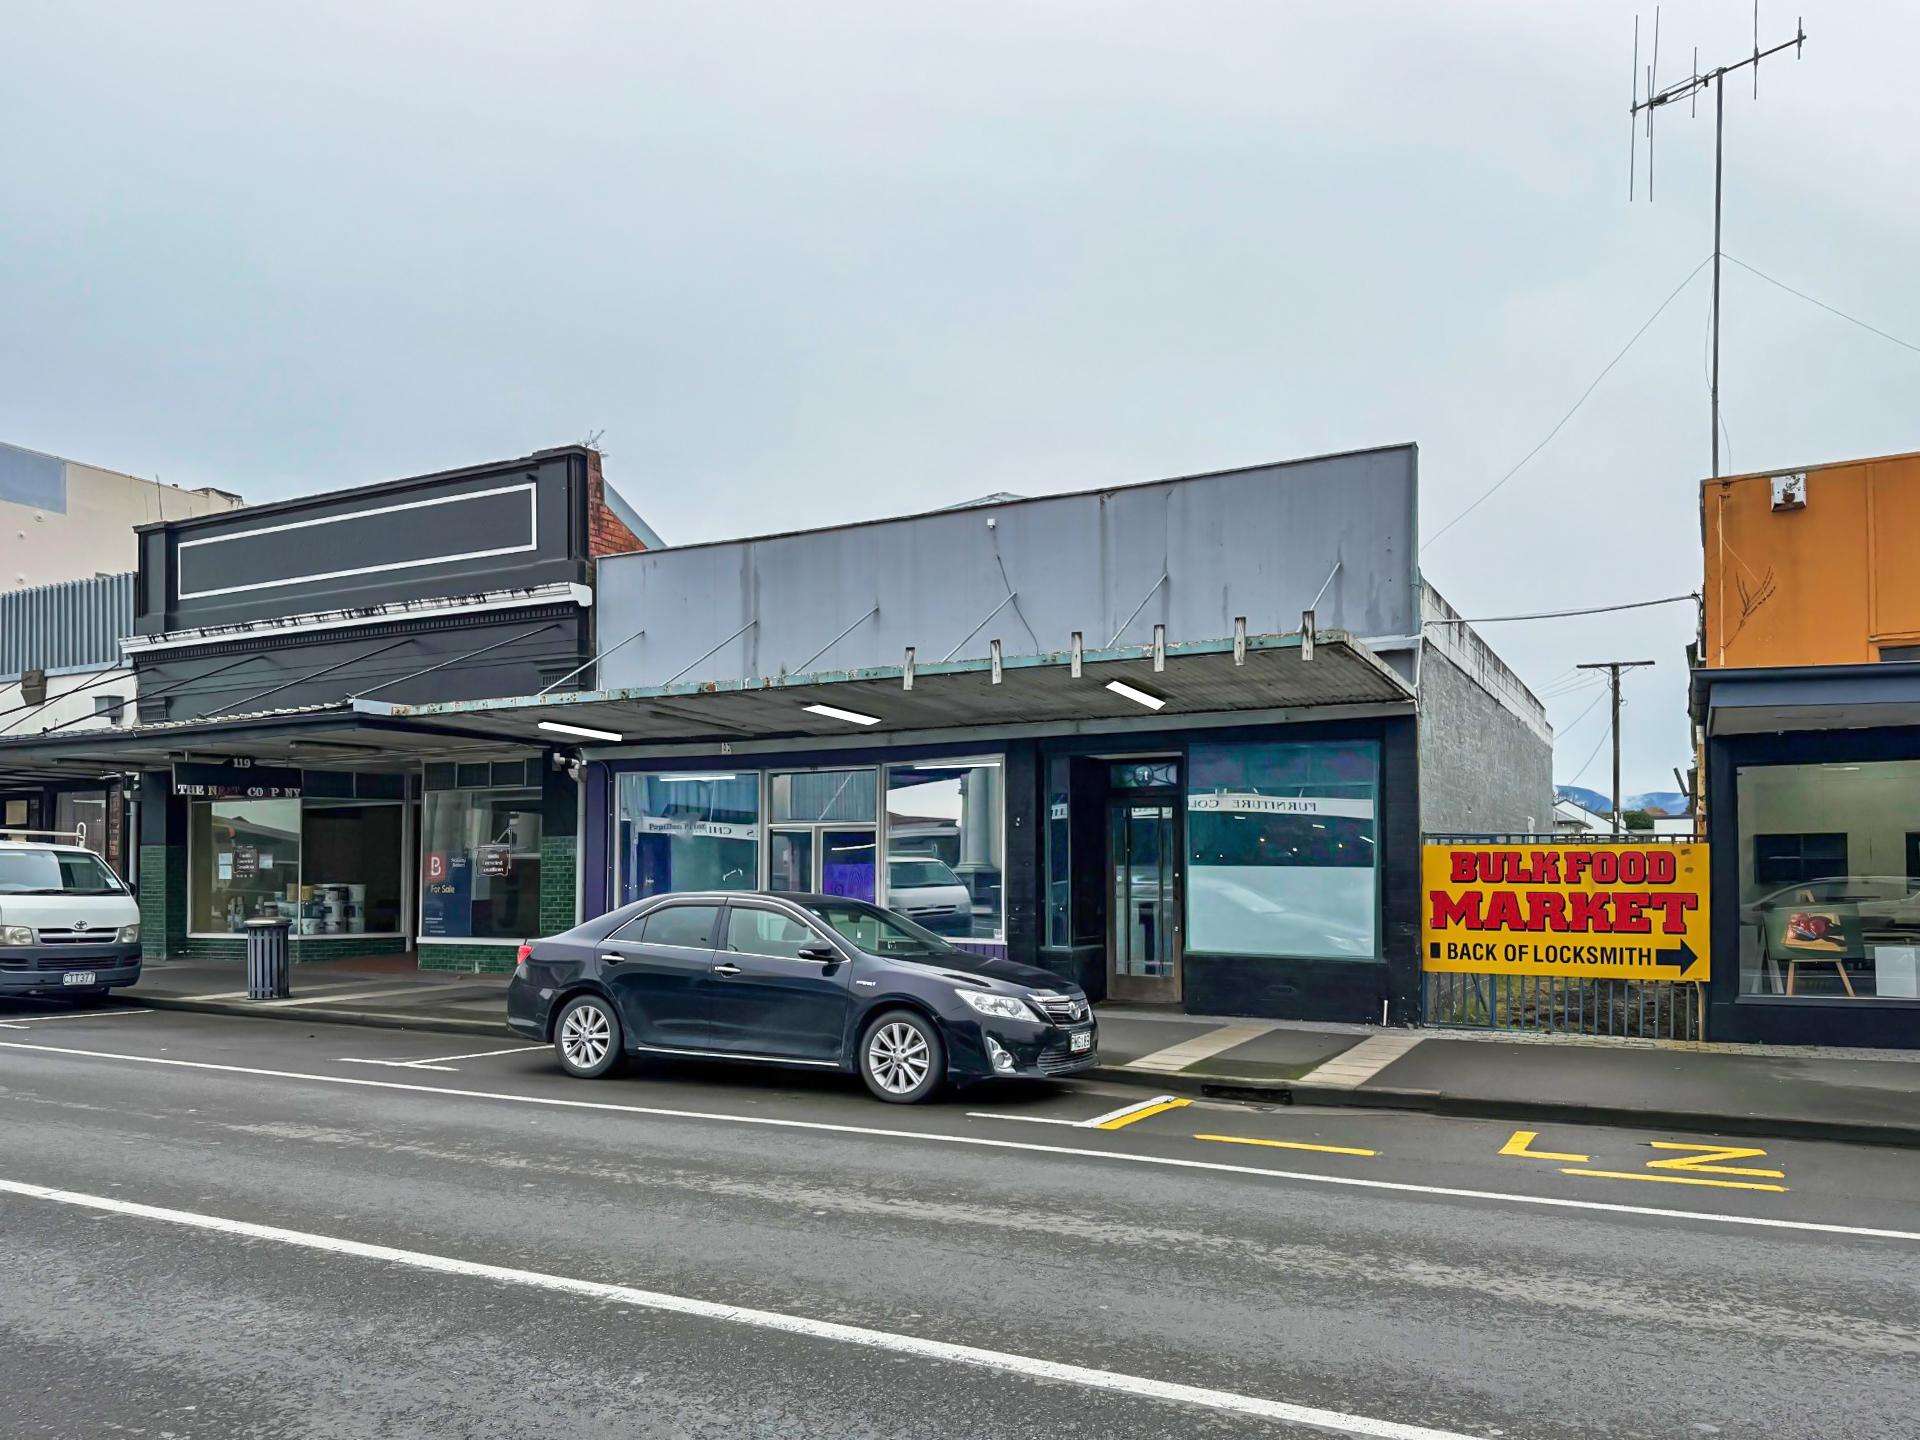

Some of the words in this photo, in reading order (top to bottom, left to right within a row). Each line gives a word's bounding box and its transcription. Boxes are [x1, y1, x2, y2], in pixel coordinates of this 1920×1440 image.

[233, 758, 251, 768] 119
[177, 784, 204, 795] THE
[247, 787, 300, 797] COPNY
[1450, 851, 1560, 883] BULK
[1564, 851, 1676, 884] FOOD
[430, 884, 440, 893] For
[441, 884, 455, 894] Sale
[1430, 891, 1699, 934] MARKET
[1447, 942, 1497, 962] BACK
[1504, 944, 1529, 963] OF
[1534, 945, 1652, 966] LOCKSMITH
